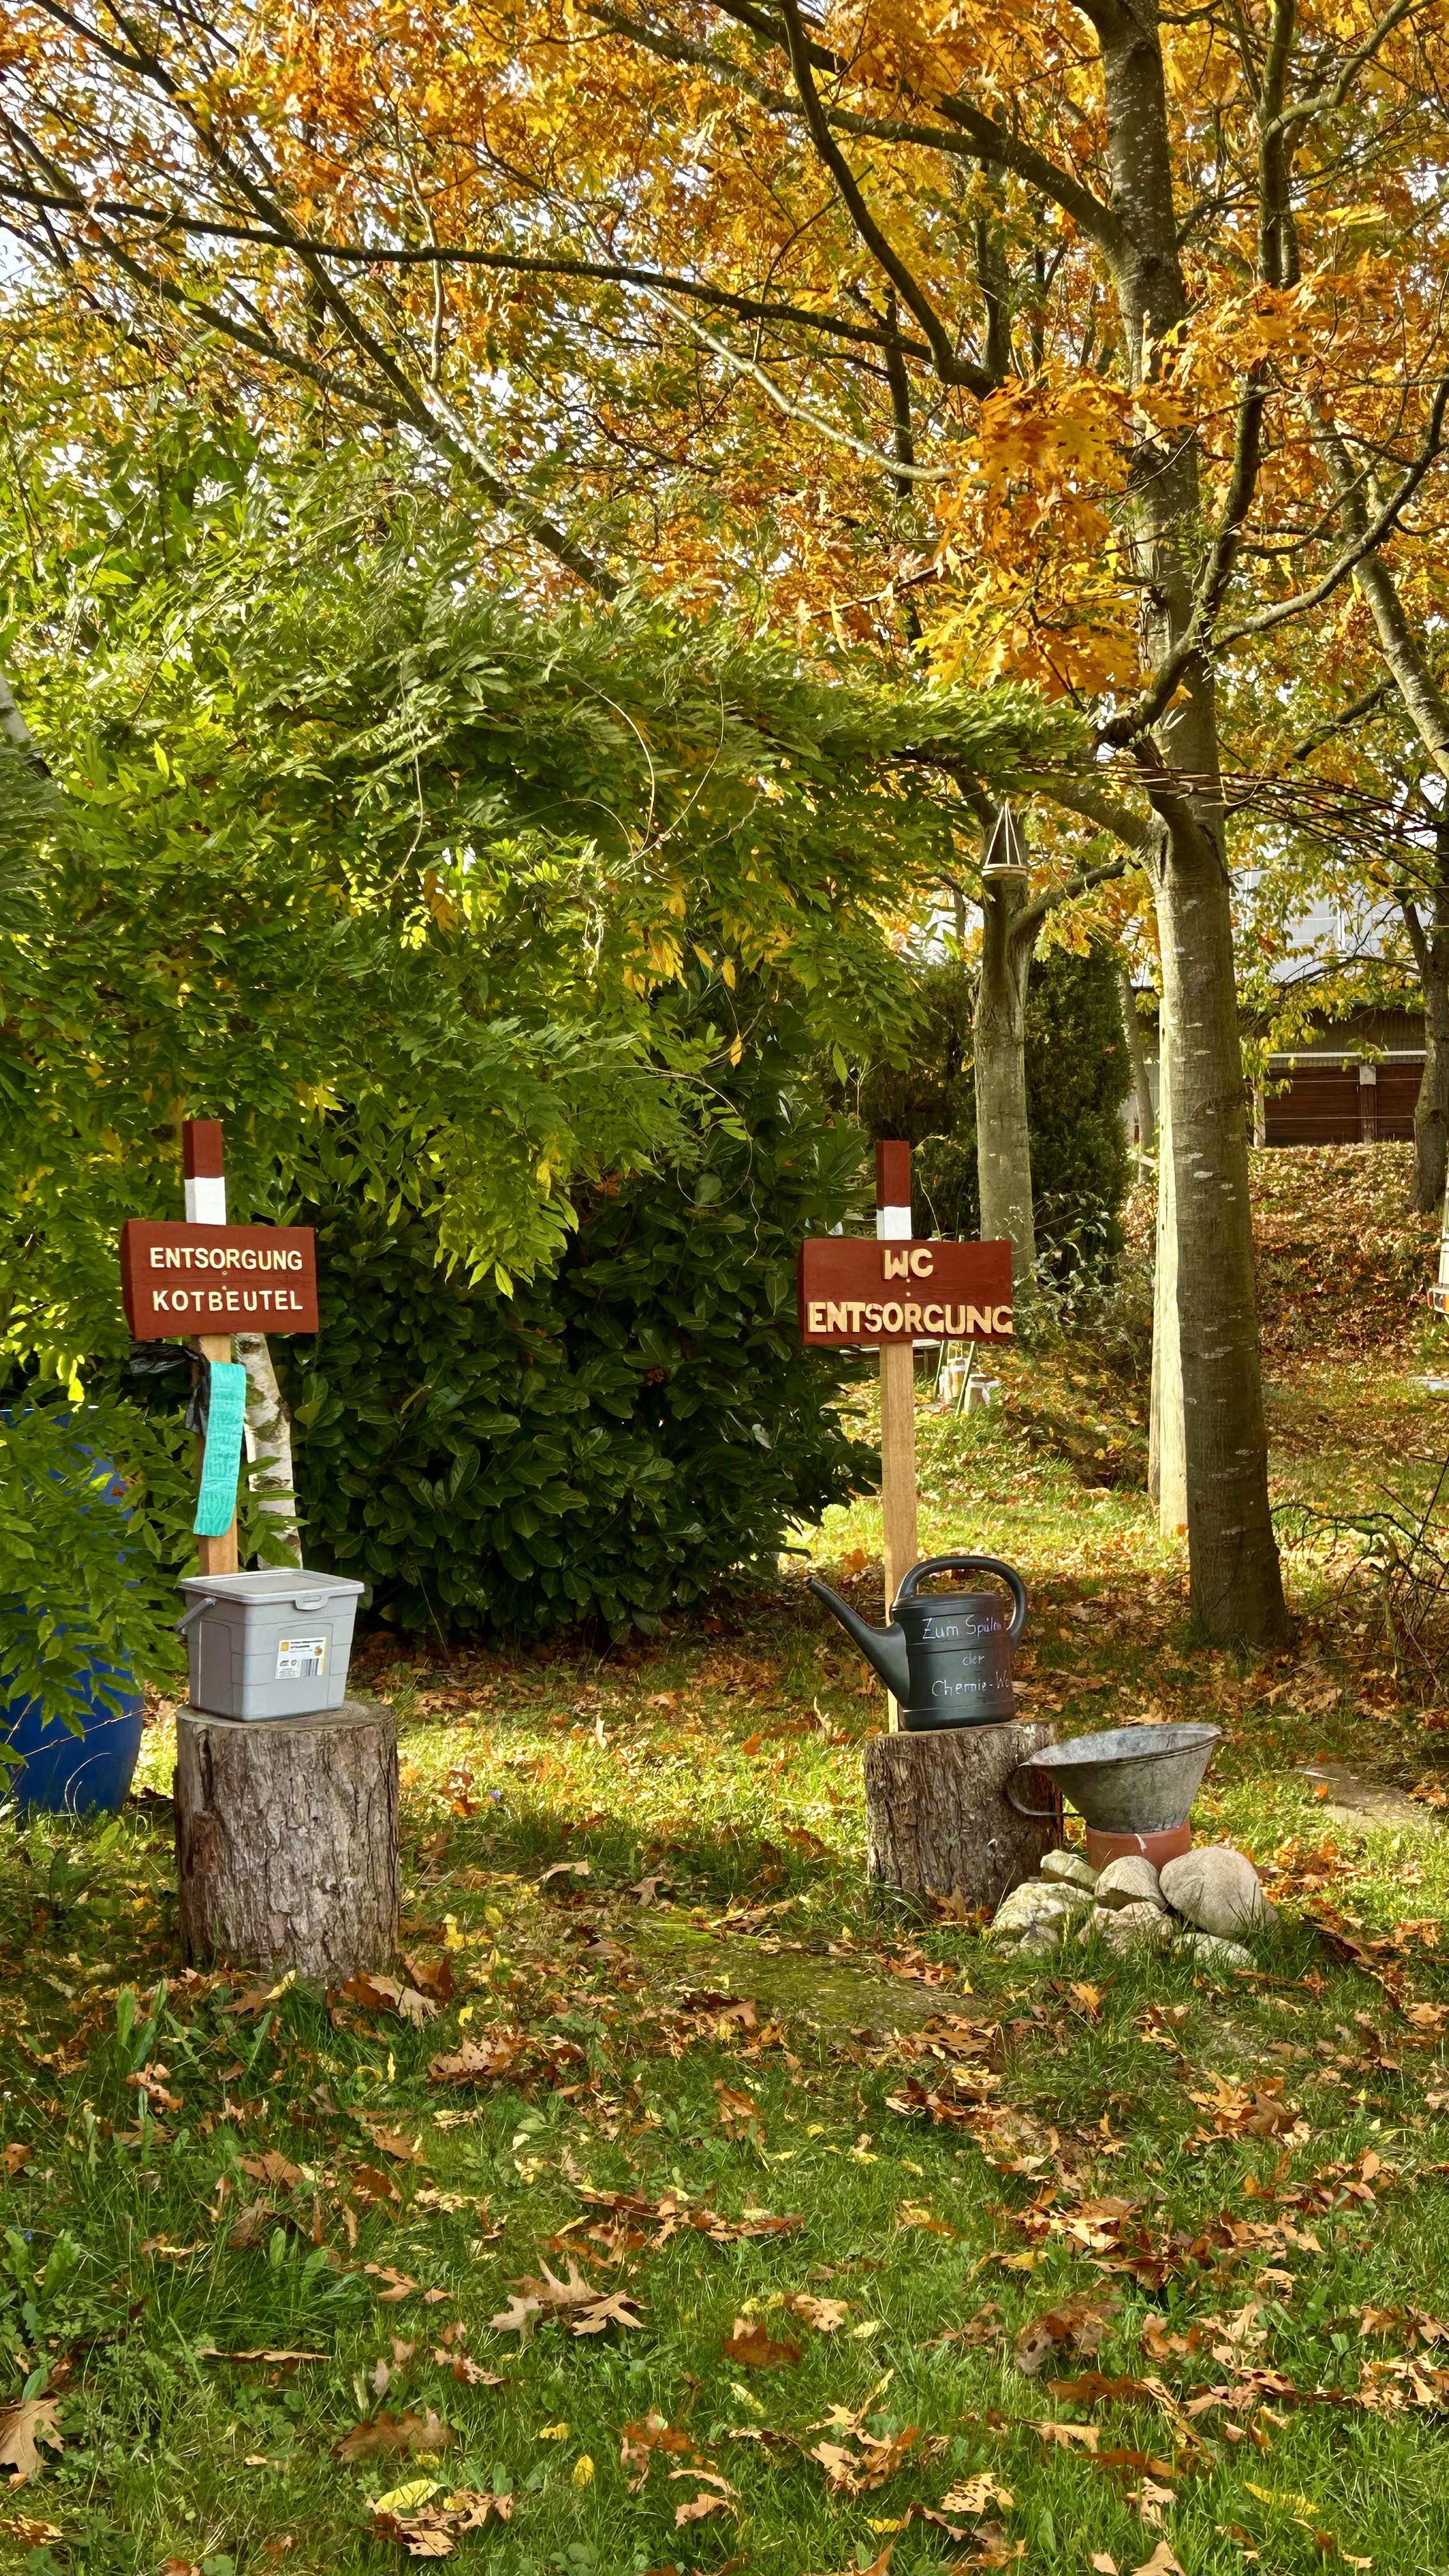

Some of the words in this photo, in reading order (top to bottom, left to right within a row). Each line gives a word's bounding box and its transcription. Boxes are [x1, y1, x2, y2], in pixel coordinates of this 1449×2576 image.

[150, 1247, 303, 1271] ENTSORGUNG
[884, 1248, 934, 1280] WC
[153, 1290, 303, 1312] KOTBEUTEL
[808, 1301, 1015, 1335] ENTSORGUNG
[922, 1617, 959, 1639] Zum
[962, 1652, 985, 1666] der
